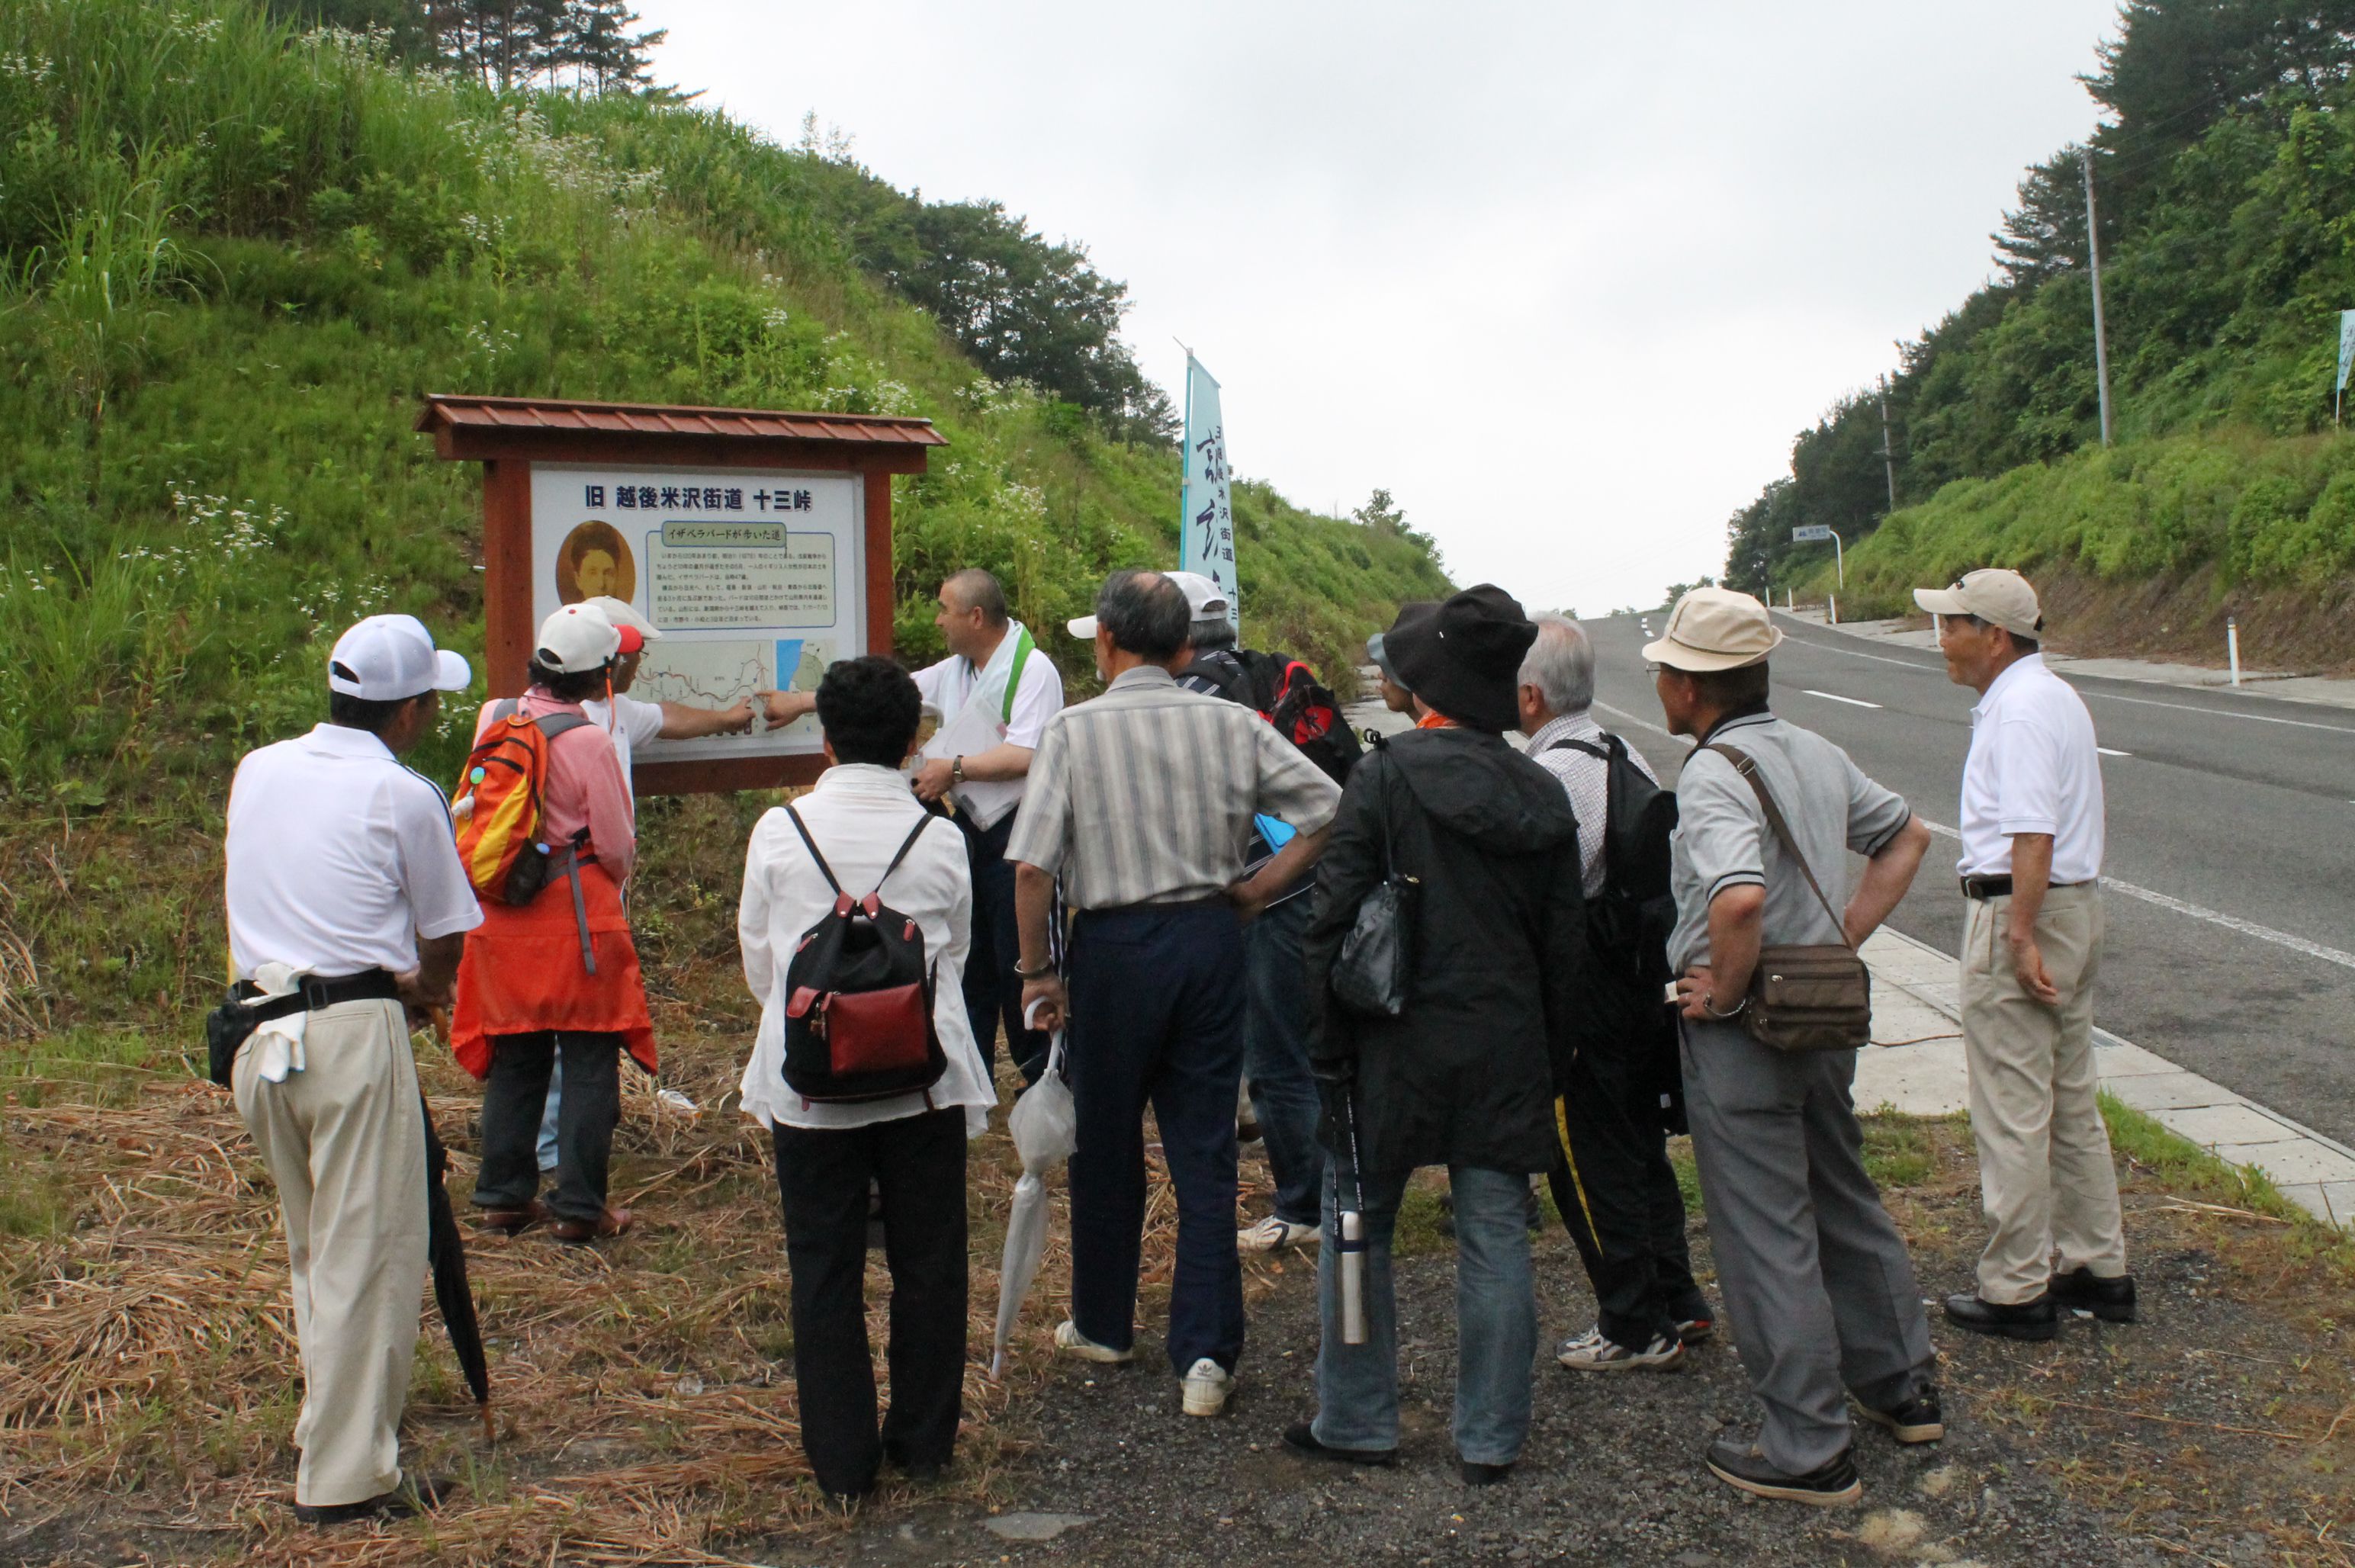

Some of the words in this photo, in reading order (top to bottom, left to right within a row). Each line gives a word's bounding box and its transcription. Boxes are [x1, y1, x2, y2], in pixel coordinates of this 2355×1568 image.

[585, 485, 605, 508] 旧
[616, 486, 744, 510] 越後米沢街道
[753, 489, 812, 512] 十三峠
[668, 529, 782, 542] イザベラバードが歩いた道
